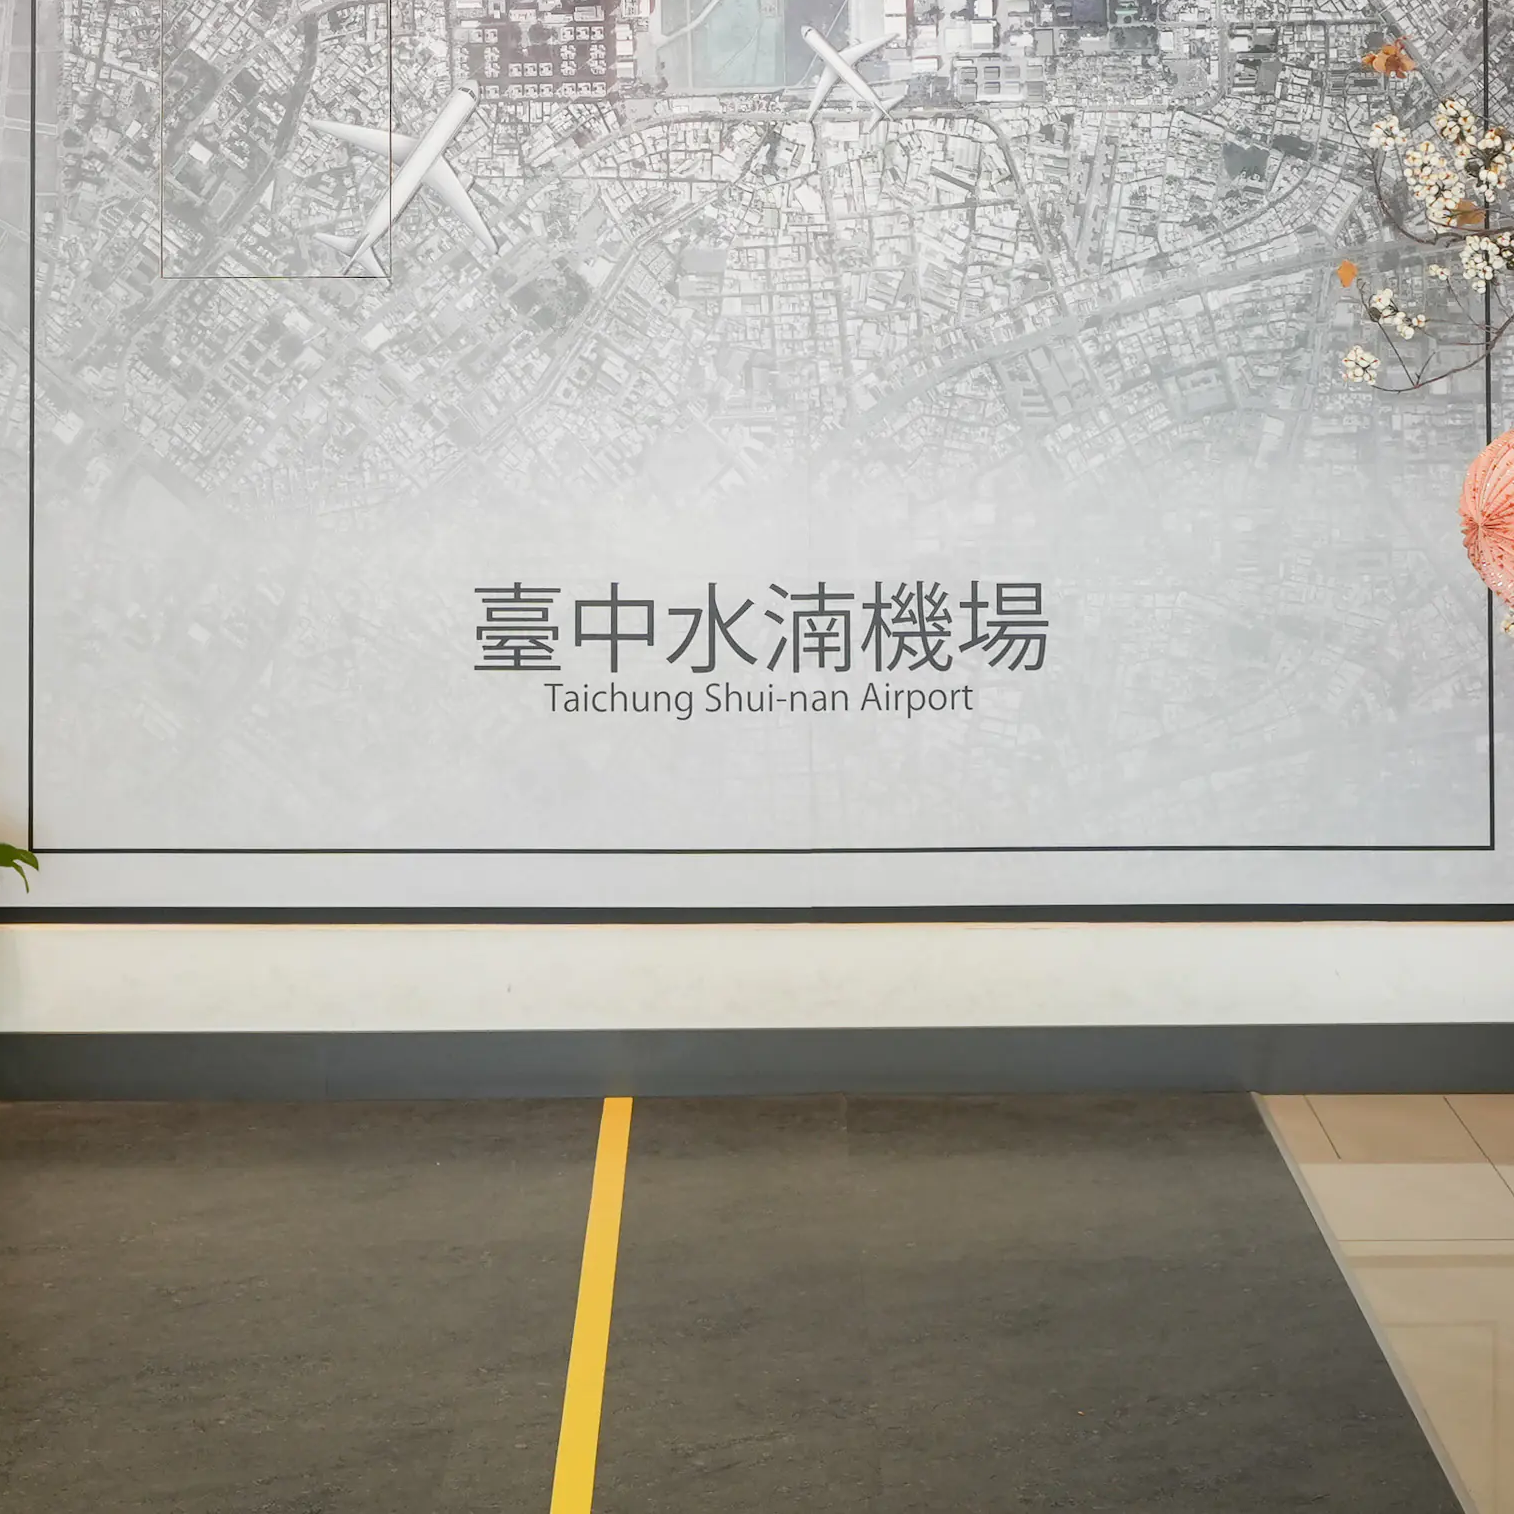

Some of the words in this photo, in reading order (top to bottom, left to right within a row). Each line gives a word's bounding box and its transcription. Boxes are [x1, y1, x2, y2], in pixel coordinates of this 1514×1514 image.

[473, 580, 1049, 674] 臺中水湳機場
[545, 683, 694, 720] Taichung
[704, 682, 850, 712] Shui-nan
[860, 682, 973, 719] Airport
